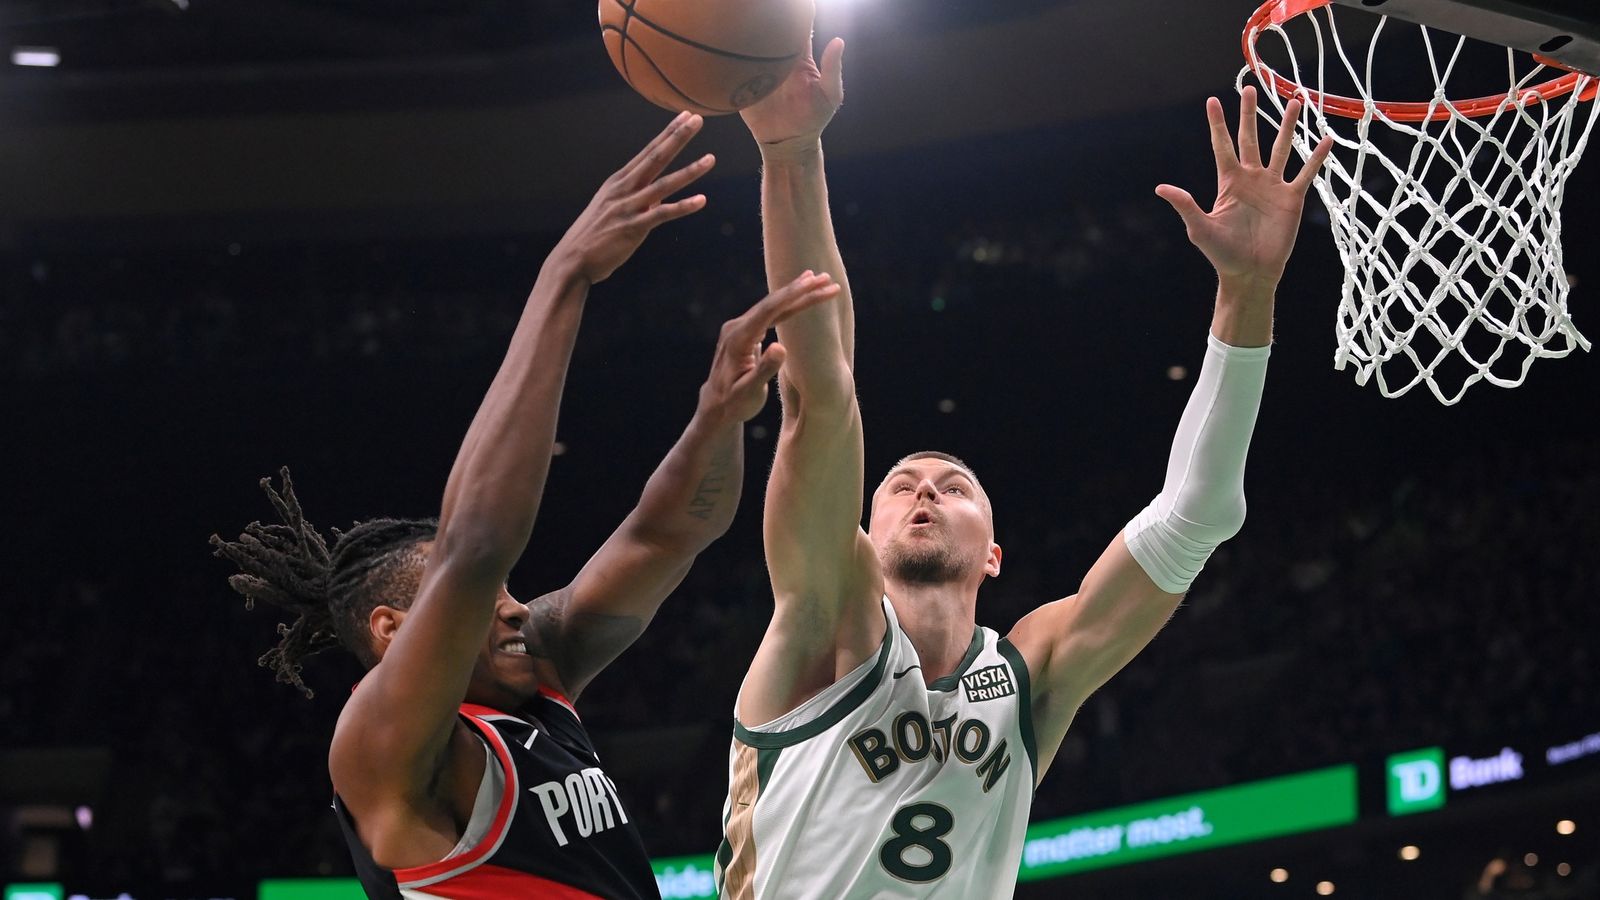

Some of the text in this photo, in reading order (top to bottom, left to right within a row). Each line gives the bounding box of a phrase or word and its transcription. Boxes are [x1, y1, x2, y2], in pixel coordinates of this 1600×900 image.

[964, 667, 1008, 689] VISTA
[969, 681, 1010, 701] PRINT
[1391, 759, 1442, 802] TD
[1449, 747, 1524, 790] Bank
[878, 800, 955, 885] 8
[1023, 806, 1214, 868] matter most.
